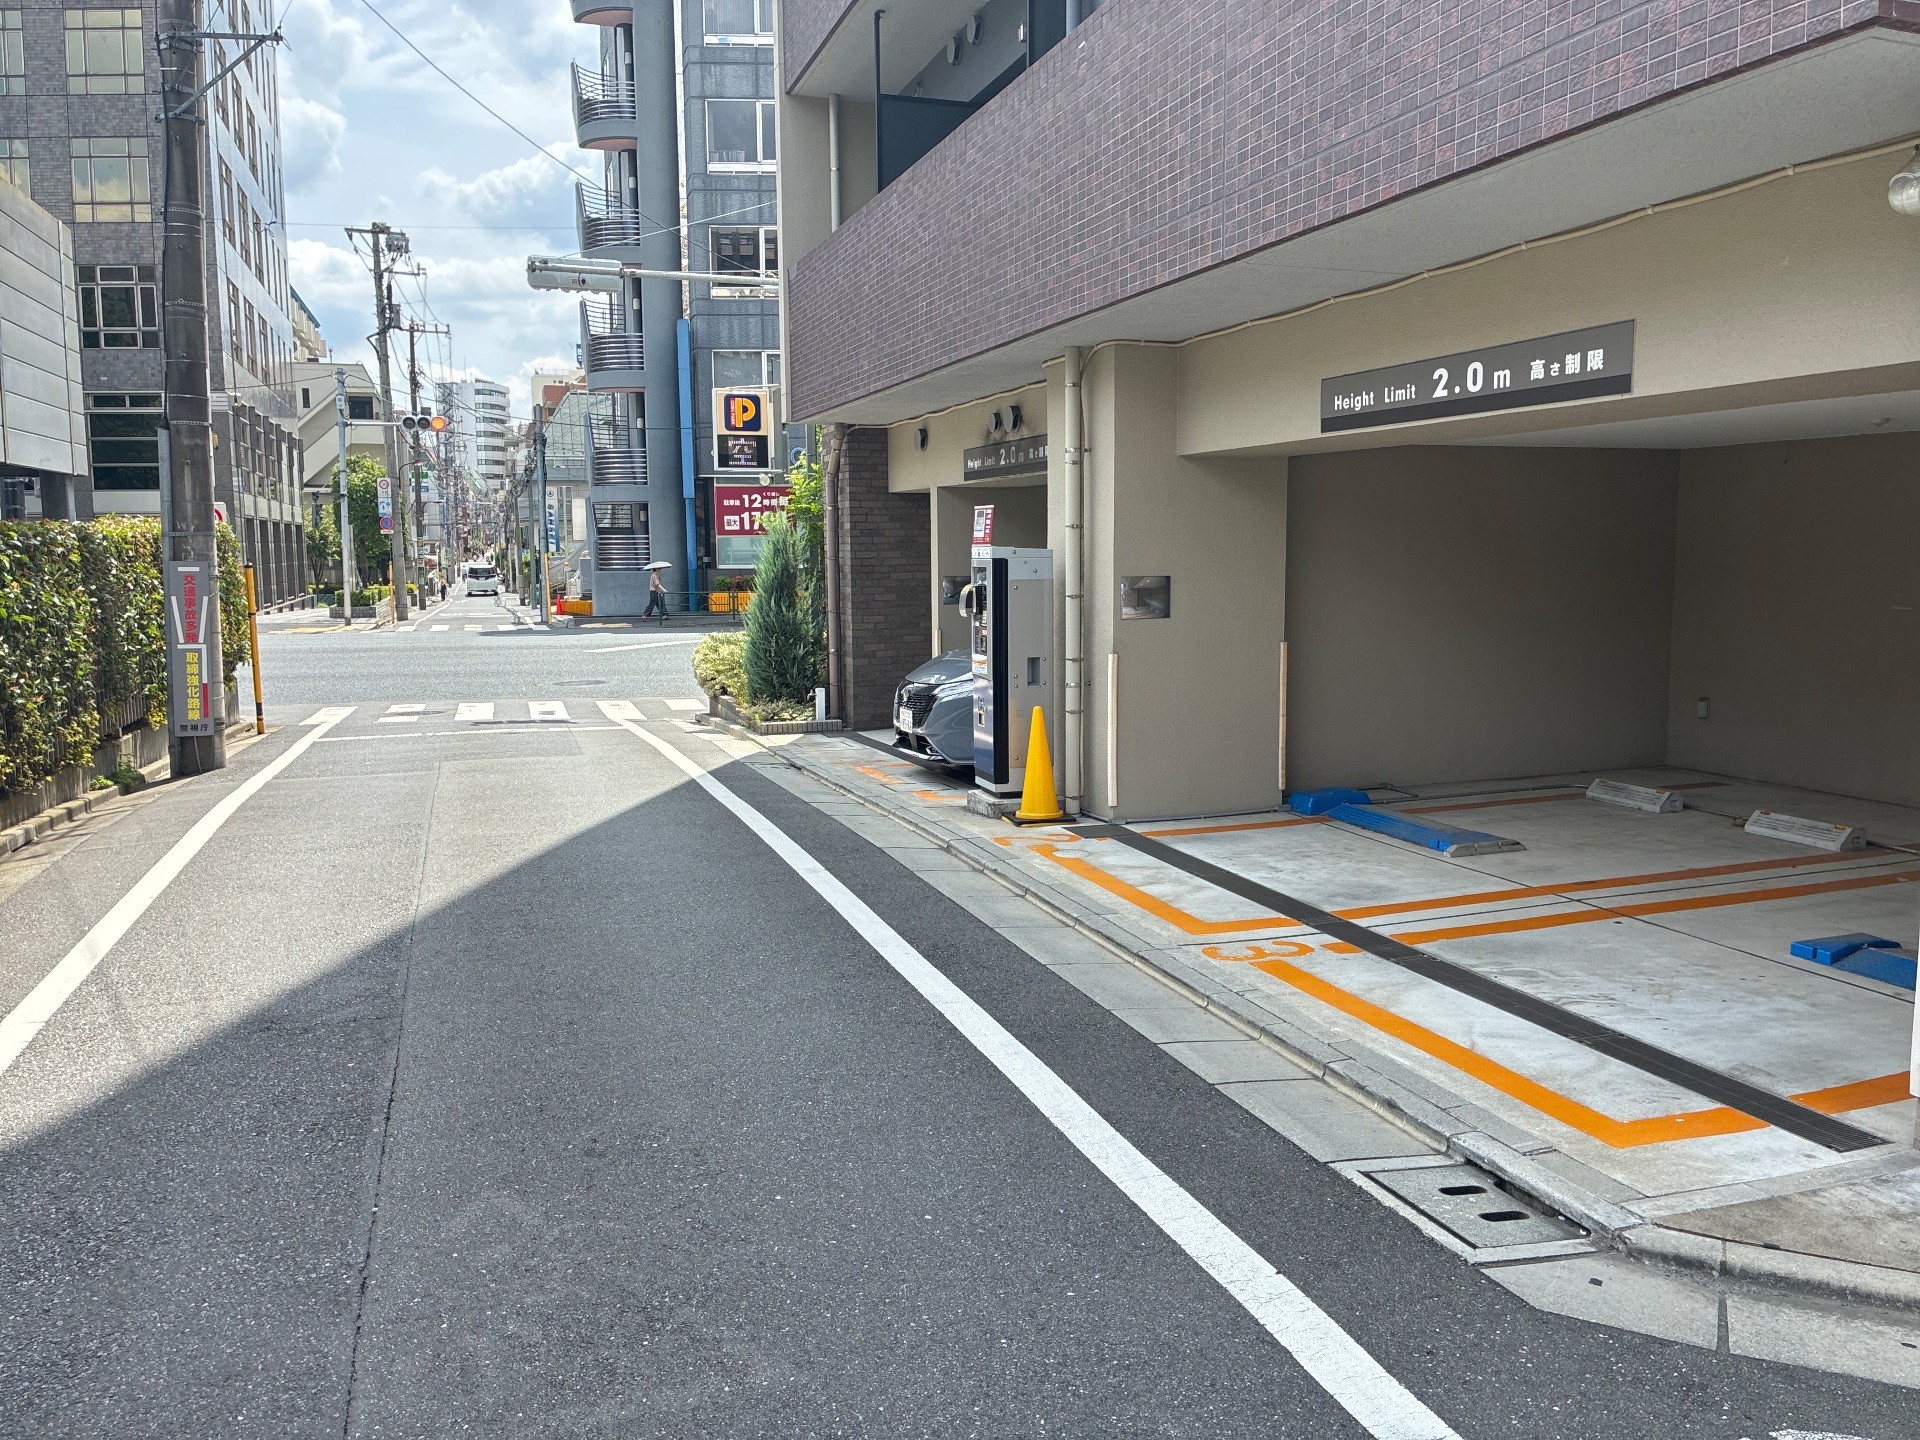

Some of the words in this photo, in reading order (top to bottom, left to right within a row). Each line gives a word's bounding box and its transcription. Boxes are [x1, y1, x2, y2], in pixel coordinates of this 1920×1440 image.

[1334, 393, 1375, 412] Height
[1383, 383, 1417, 404] Limit
[1432, 361, 1484, 399] 2.0
[1493, 368, 1511, 390] m
[1529, 347, 1605, 381] 高さ制限
[999, 446, 1016, 465] 2.0
[183, 574, 198, 643] 交通事故多発
[185, 652, 200, 721] 取締強化路線
[179, 723, 209, 732] 警視庁
